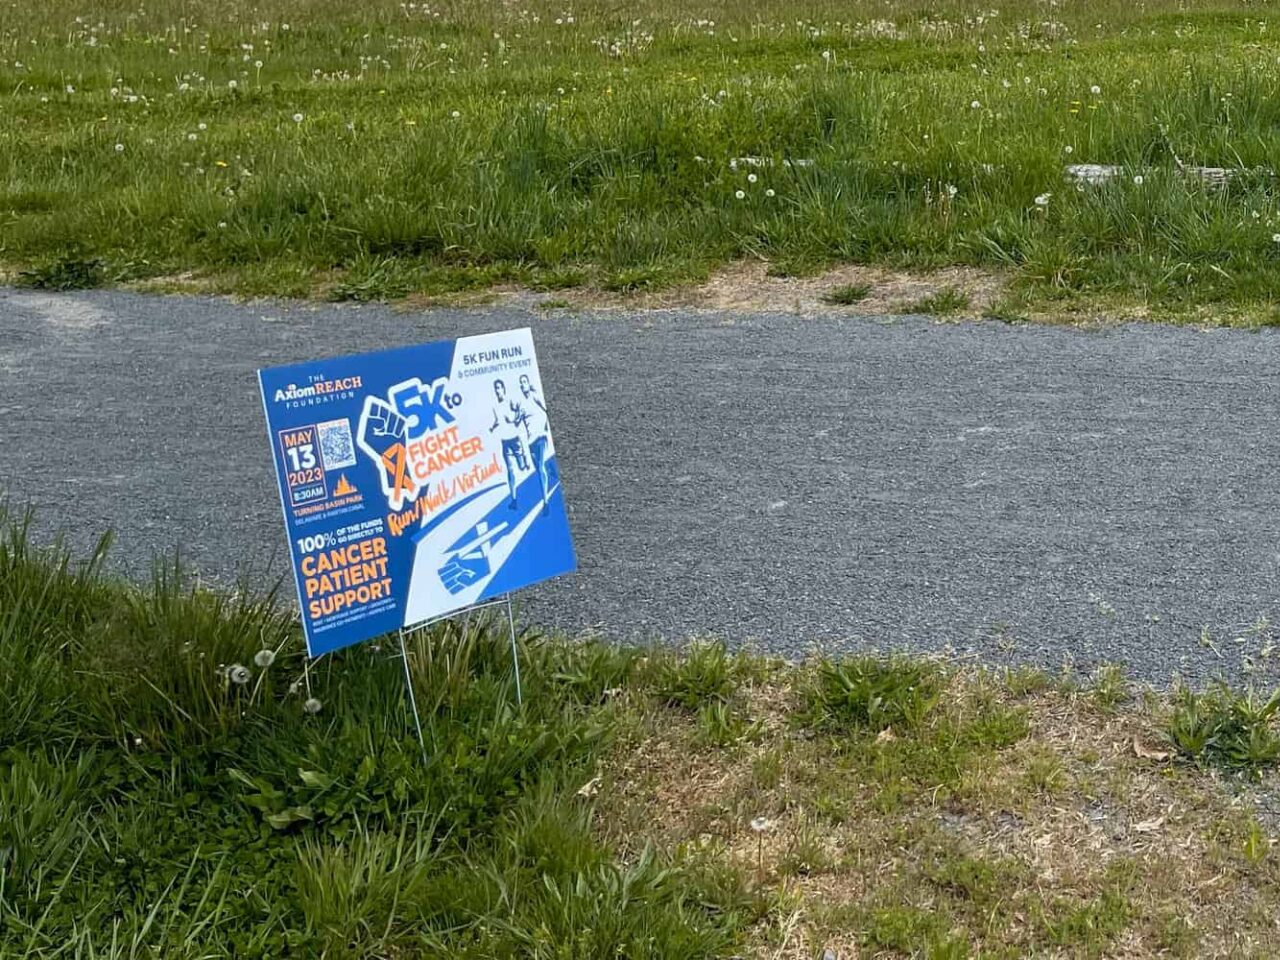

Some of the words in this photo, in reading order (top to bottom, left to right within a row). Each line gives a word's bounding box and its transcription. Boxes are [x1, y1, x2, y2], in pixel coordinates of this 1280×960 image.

[463, 353, 477, 365] 5K
[478, 350, 499, 363] FUN
[501, 345, 522, 359] RUN
[463, 362, 508, 377] COMMUNITY
[508, 359, 532, 371] EVENT
[308, 374, 325, 383] THE
[286, 392, 354, 410] FOUNDATION
[394, 383, 456, 440] 5K
[444, 392, 463, 409] to
[284, 430, 313, 447] MAY
[408, 425, 460, 461] FIGHT
[287, 444, 316, 471] 13
[414, 436, 484, 479] CANCER
[289, 468, 322, 486] 2023
[346, 495, 363, 505] PARK
[336, 528, 346, 536] OF
[346, 524, 360, 533] THE
[360, 518, 383, 530] FUNDS
[374, 526, 384, 534] TO
[297, 531, 337, 554] 100%
[301, 537, 388, 577] CANCER
[305, 556, 389, 599] PATIENT
[308, 578, 393, 619] SUPPORT
